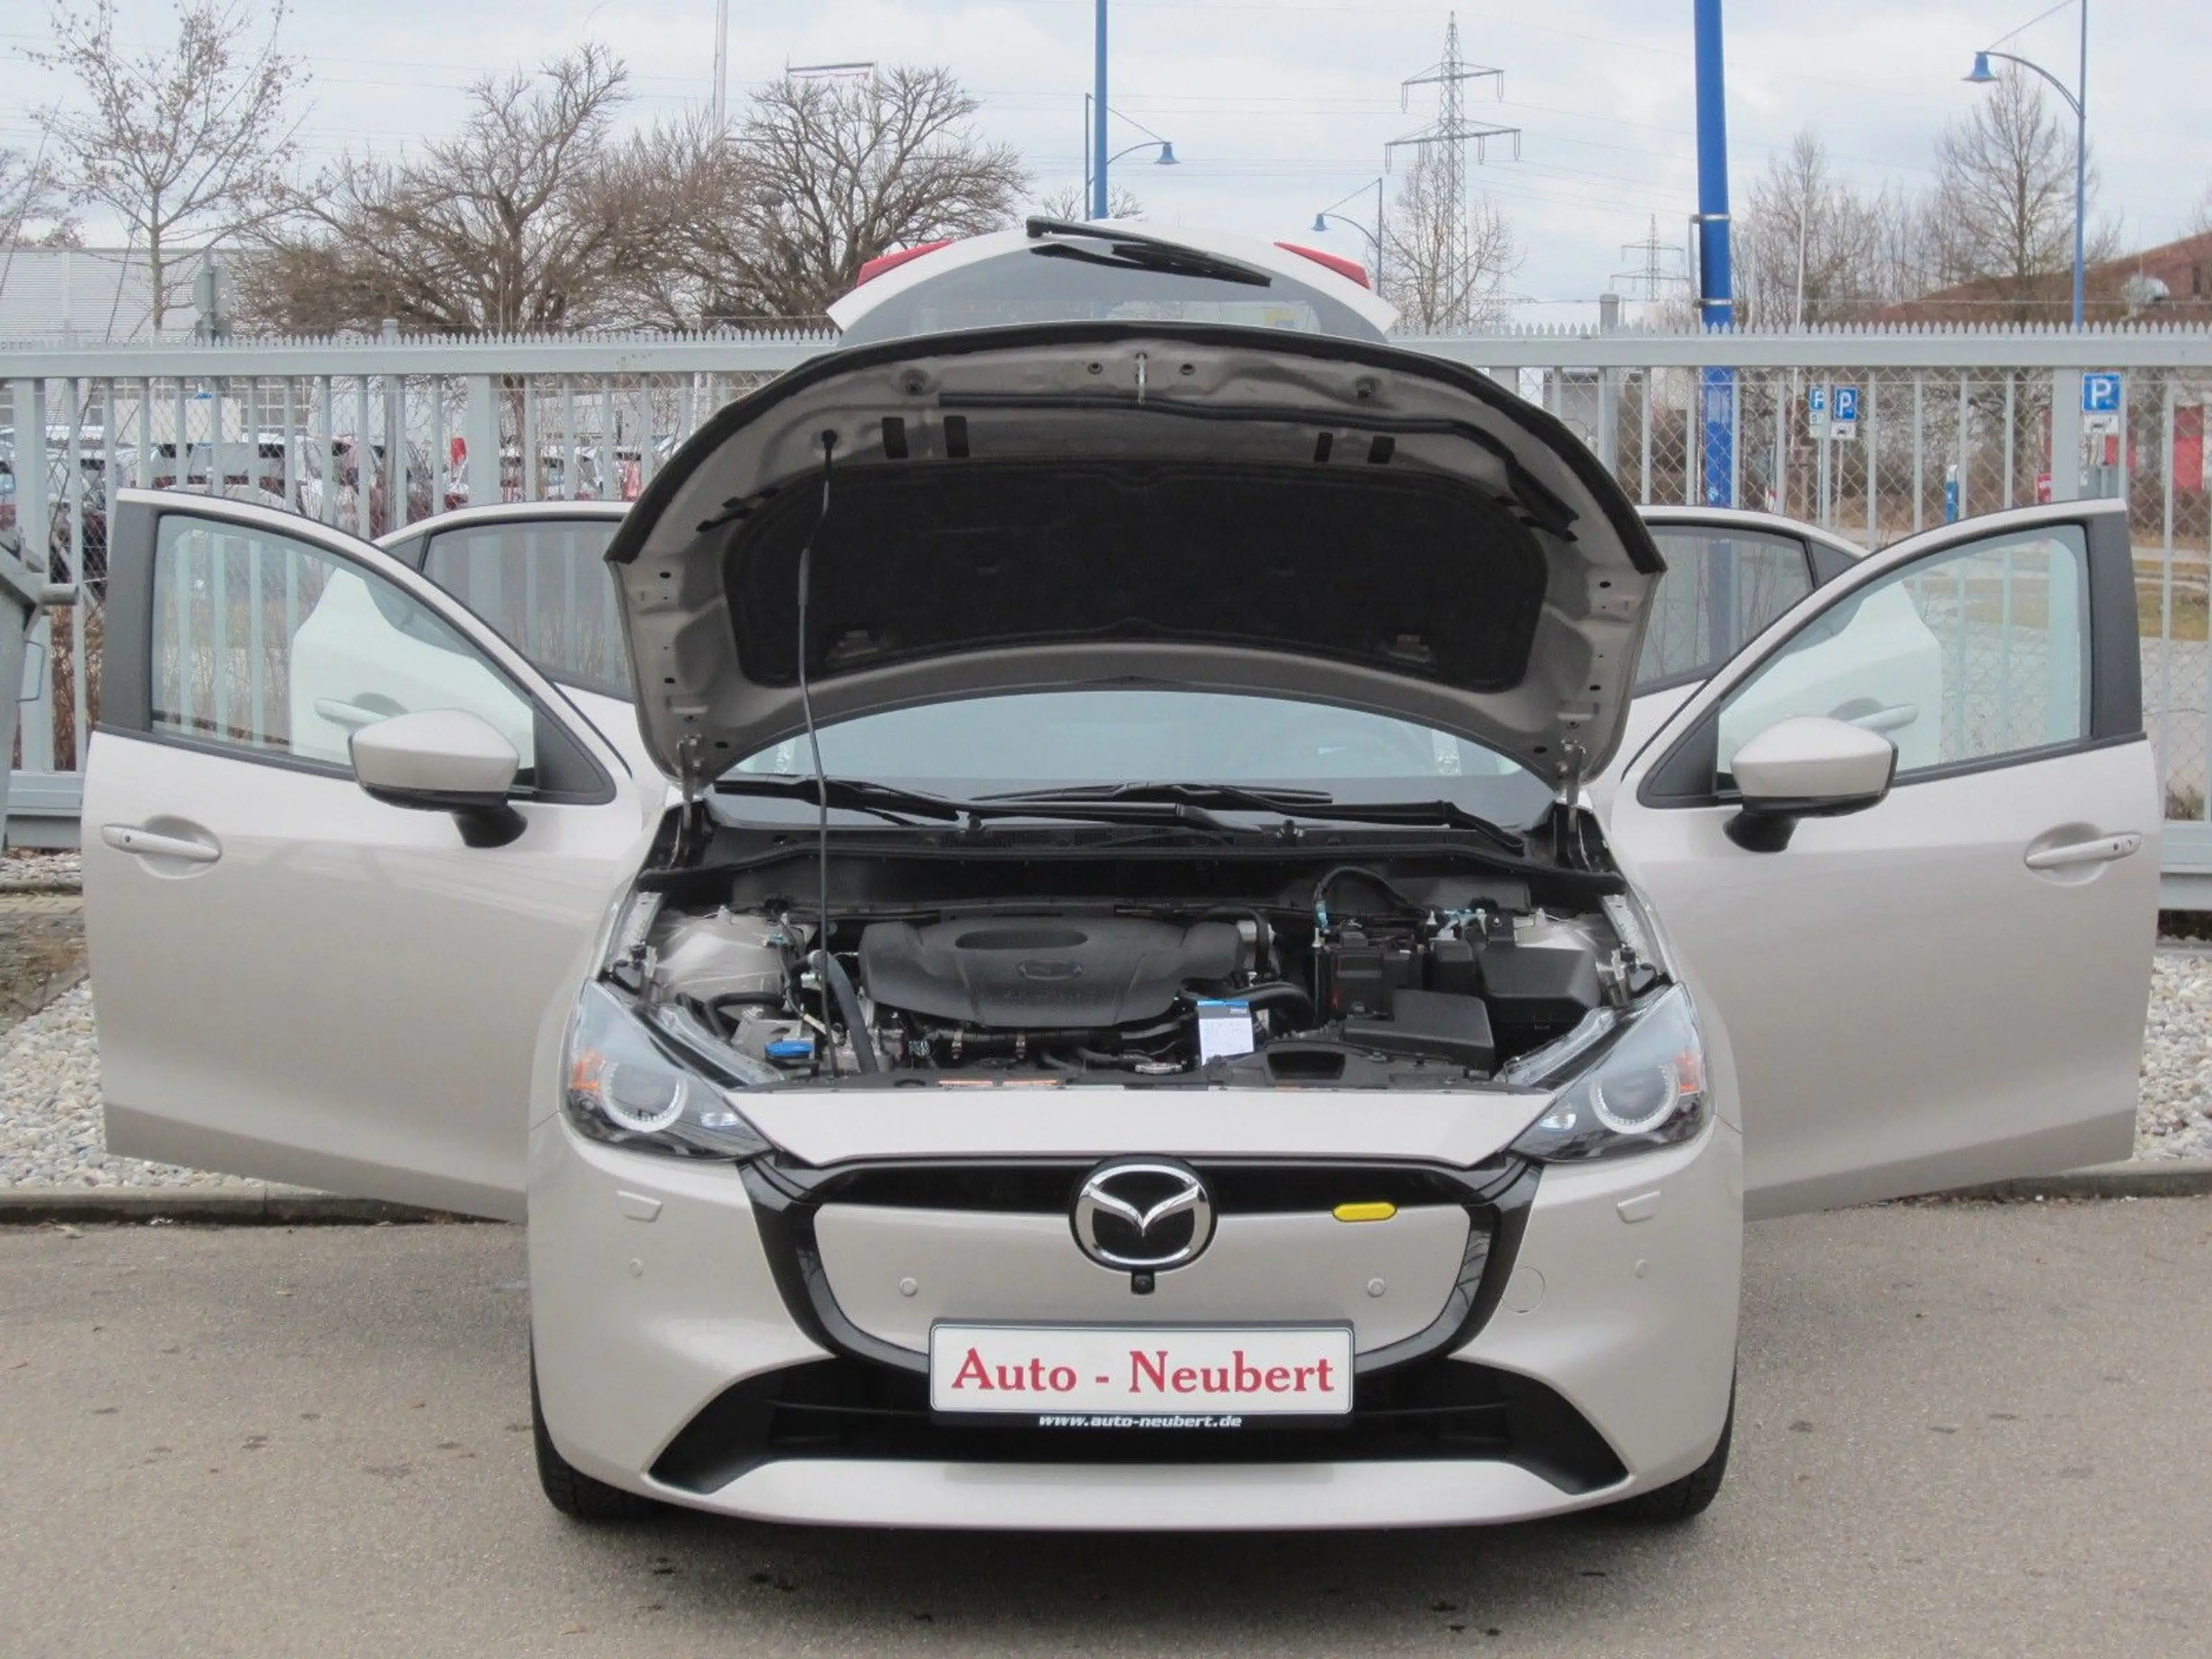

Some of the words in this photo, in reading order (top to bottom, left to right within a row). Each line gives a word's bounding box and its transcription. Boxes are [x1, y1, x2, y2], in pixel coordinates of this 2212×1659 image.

[1840, 391, 1852, 416] P
[2092, 378, 2111, 408] P
[952, 1347, 1077, 1391] Auto
[1096, 1375, 1110, 1384] -
[1129, 1350, 1335, 1393] Neubert
[1039, 1415, 1243, 1428] www.auto-neubert.de
